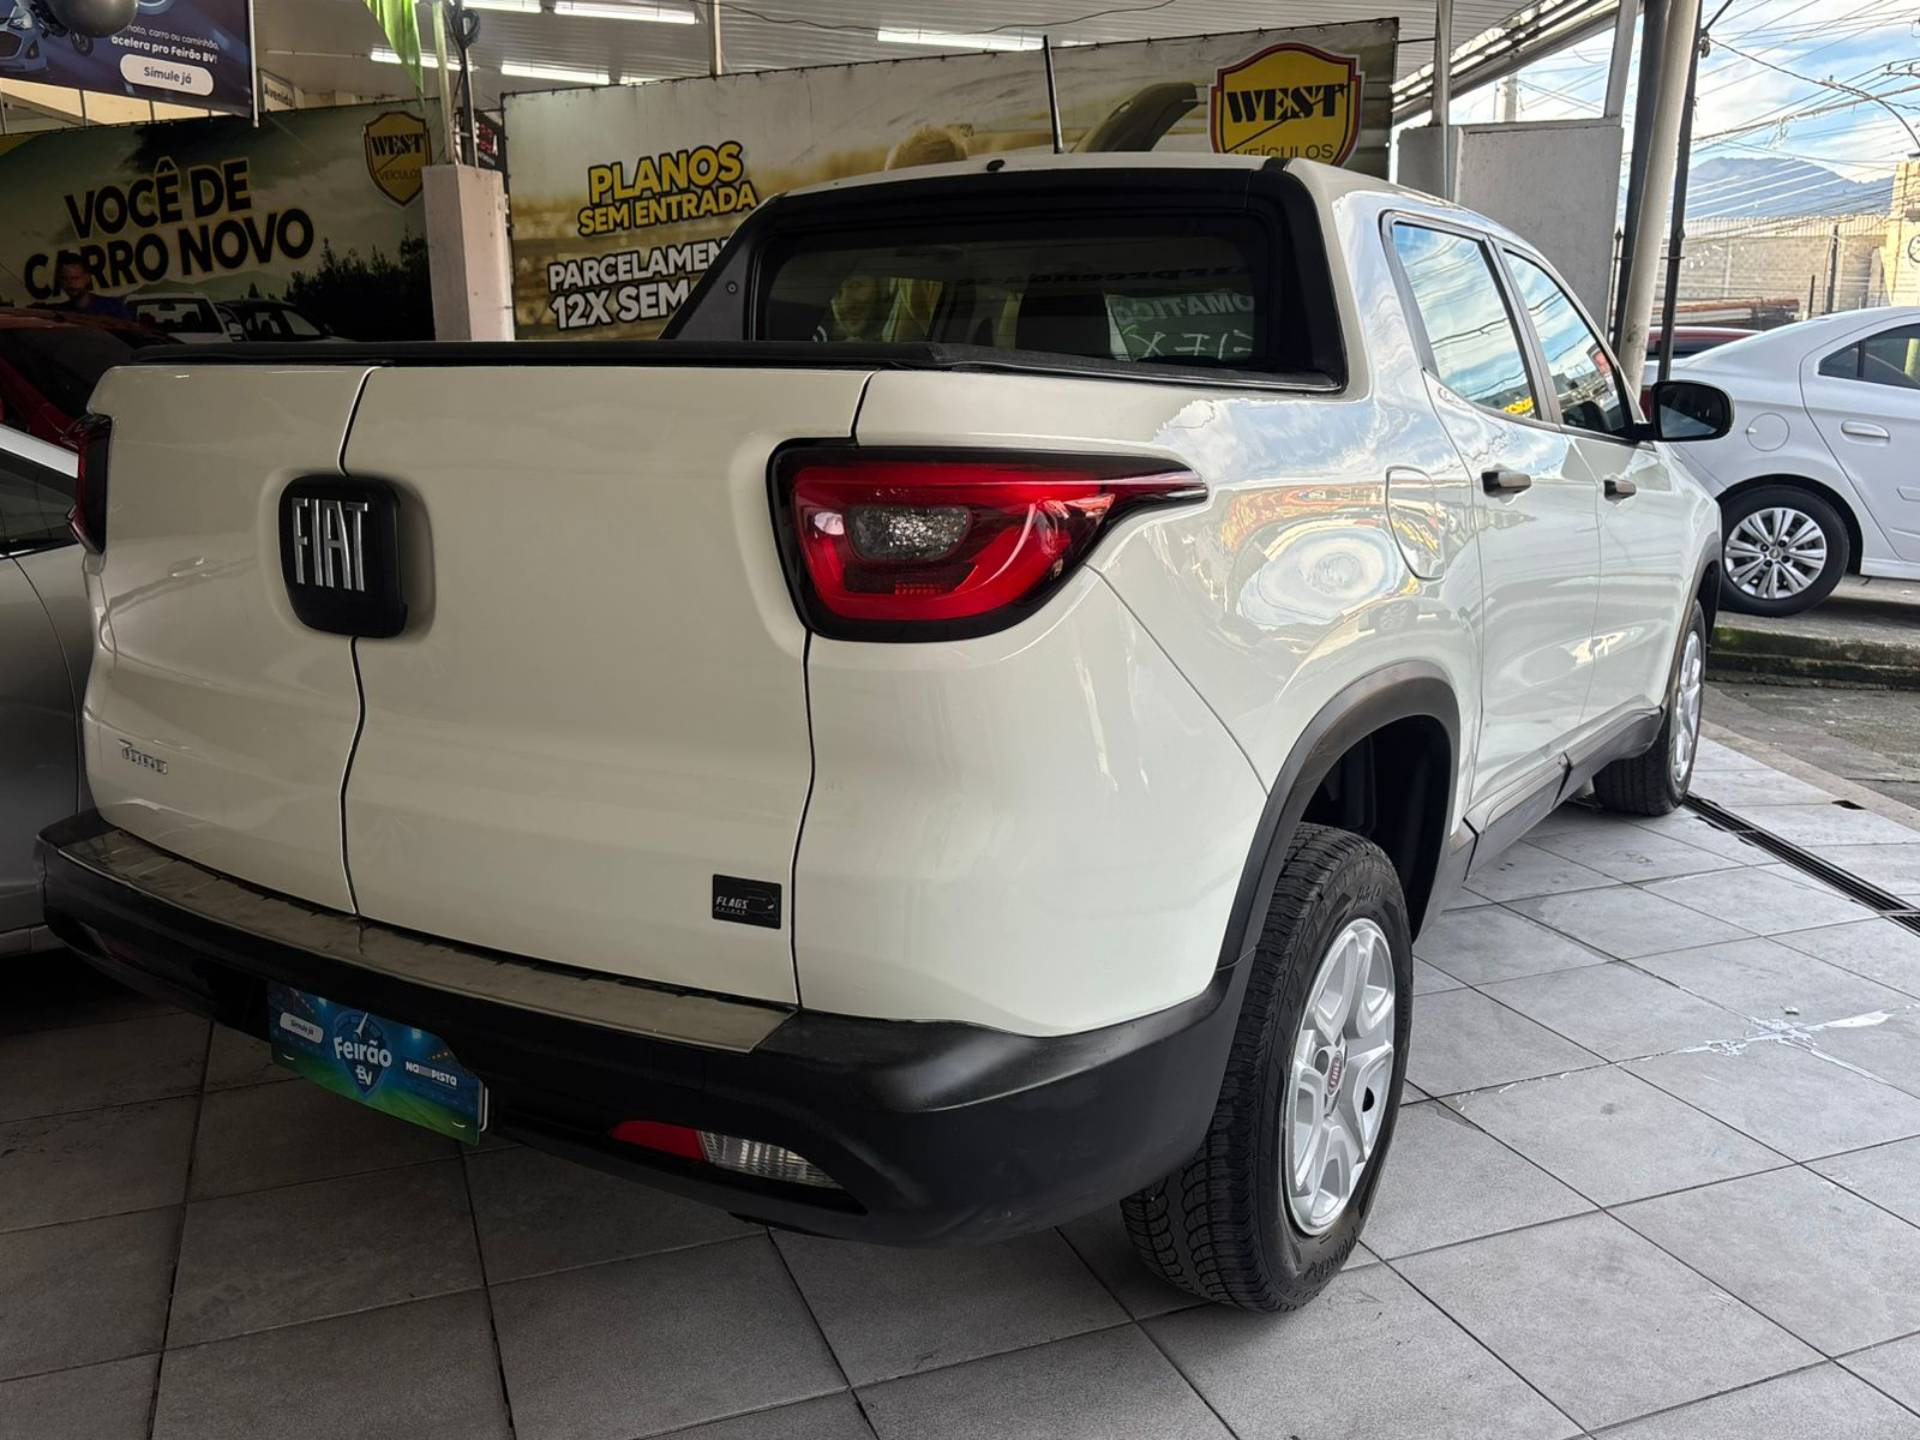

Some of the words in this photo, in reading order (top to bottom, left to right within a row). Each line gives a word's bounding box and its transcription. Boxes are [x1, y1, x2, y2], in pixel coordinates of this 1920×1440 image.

[111, 36, 150, 51] acelera
[151, 42, 170, 54] pro
[171, 46, 201, 61] Feirão
[148, 28, 170, 40] carro
[170, 32, 181, 42] ou
[143, 66, 180, 82] Simule
[180, 72, 192, 86] já
[1226, 83, 1346, 123] WEST
[370, 133, 424, 157] WEST
[588, 141, 743, 206] PLANOS
[64, 160, 183, 240] VOCÊ
[191, 160, 252, 219] DE
[578, 201, 632, 237] SEM
[634, 181, 759, 228] ENTRADA
[24, 233, 169, 301] CARRO
[177, 208, 314, 277] NOVO
[551, 289, 613, 331] 12X
[616, 278, 691, 323] SEM
[291, 497, 369, 592] FIAT
[716, 895, 749, 909] FLAGS
[333, 1036, 393, 1067] Feirão
[354, 1064, 373, 1086] BV
